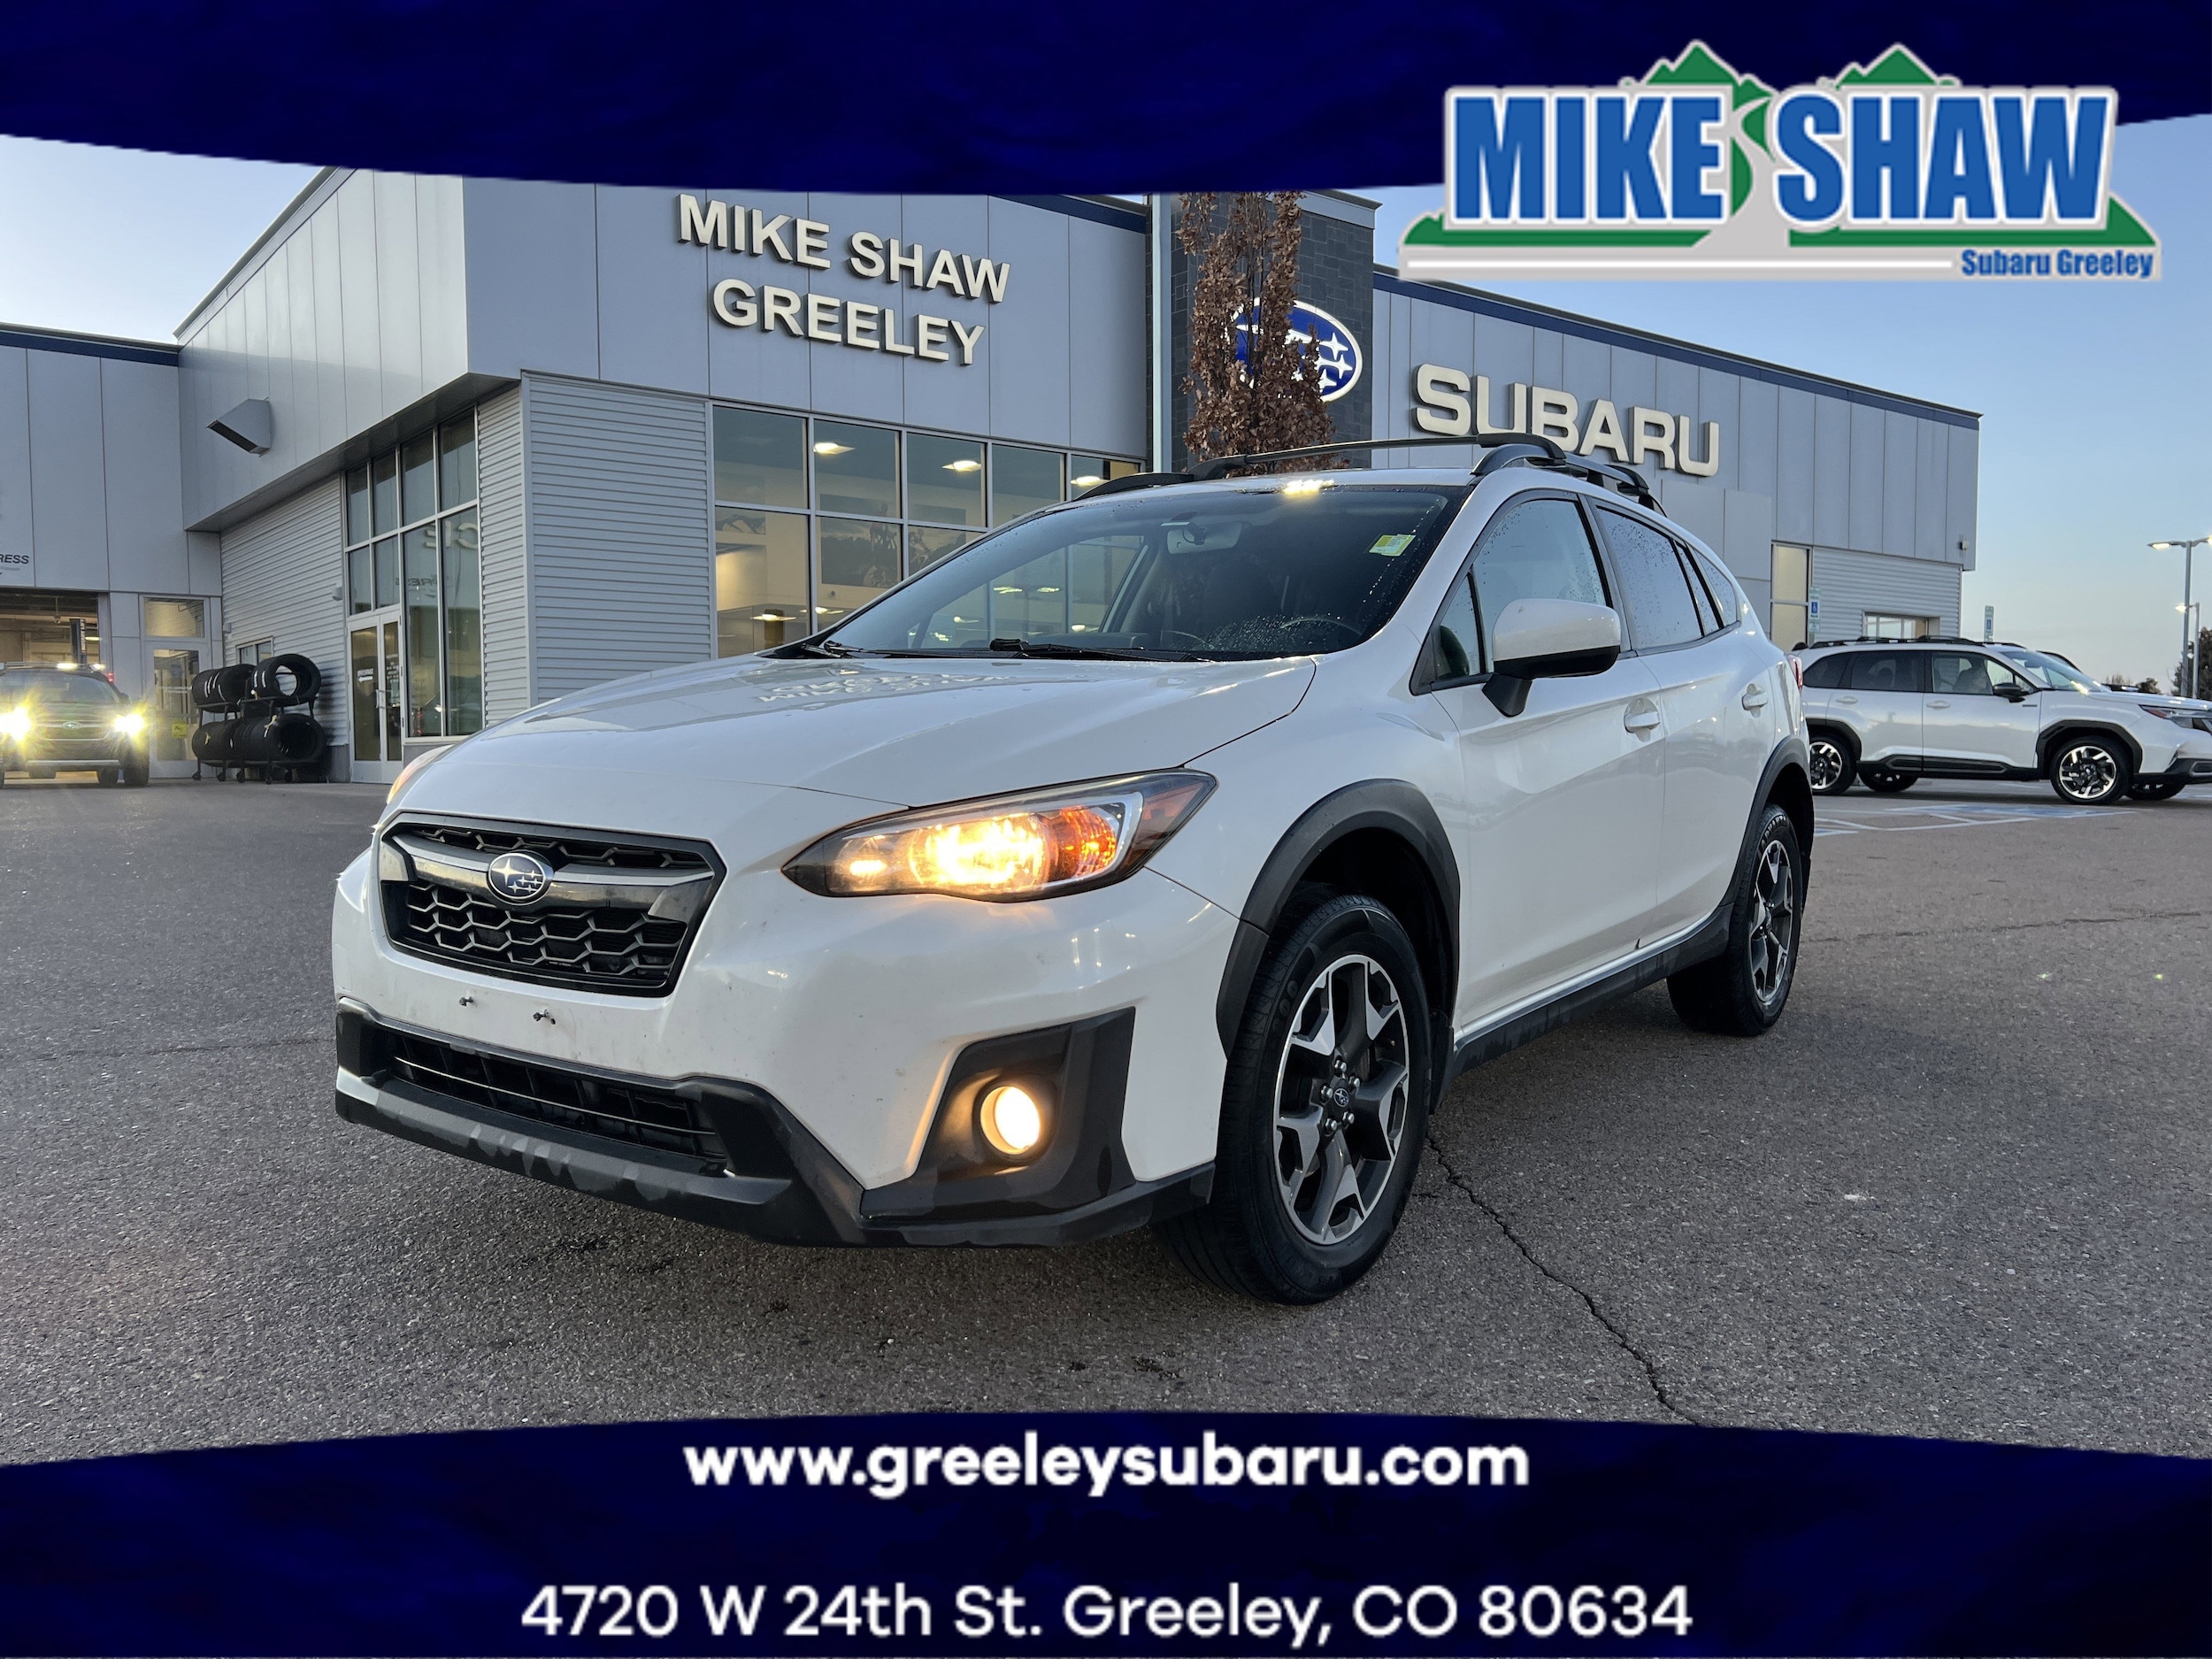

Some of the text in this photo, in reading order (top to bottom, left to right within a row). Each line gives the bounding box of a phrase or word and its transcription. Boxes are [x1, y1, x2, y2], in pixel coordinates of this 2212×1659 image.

[676, 193, 1010, 304] MIKE SHAW
[711, 278, 986, 366] GREELEY
[1413, 363, 1719, 477] SUBARU
